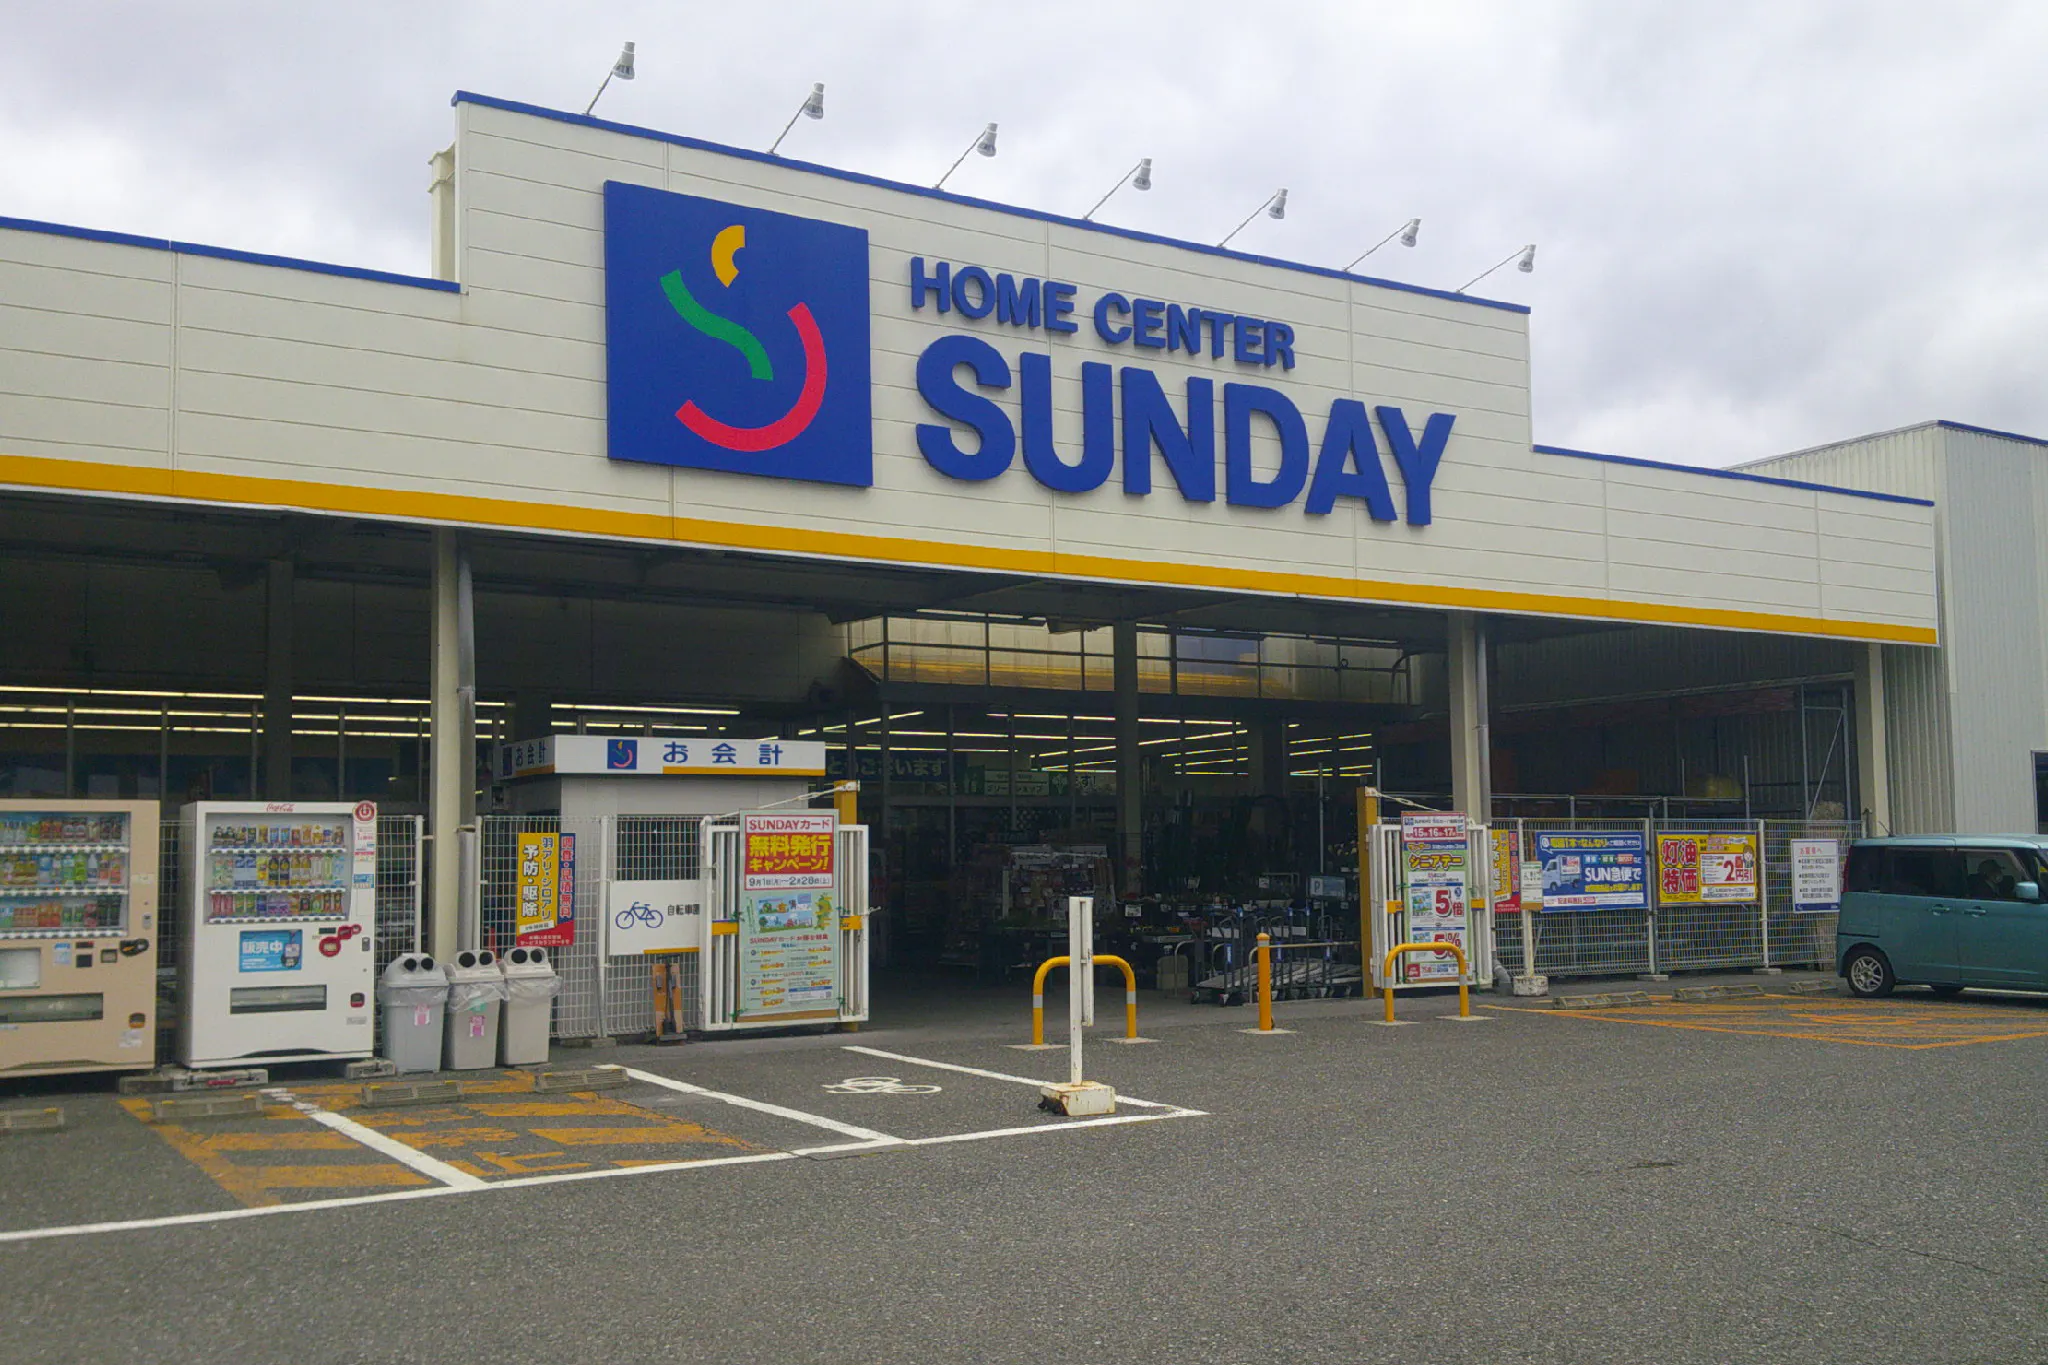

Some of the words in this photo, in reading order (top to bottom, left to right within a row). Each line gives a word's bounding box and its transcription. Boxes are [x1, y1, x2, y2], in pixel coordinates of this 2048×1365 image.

[910, 256, 1078, 334] HOME
[1094, 292, 1296, 371] CENTER
[915, 335, 1456, 526] SUNDAY
[662, 740, 784, 766] お会計
[748, 819, 831, 832] SUNDAYカード
[748, 834, 832, 857] 無料発行
[1662, 840, 1698, 866] 灯油
[748, 857, 829, 873] キャンペーン!
[1584, 867, 1642, 882] SUN急便で
[522, 843, 539, 918] 予防・駆除
[1662, 868, 1698, 894] 特価
